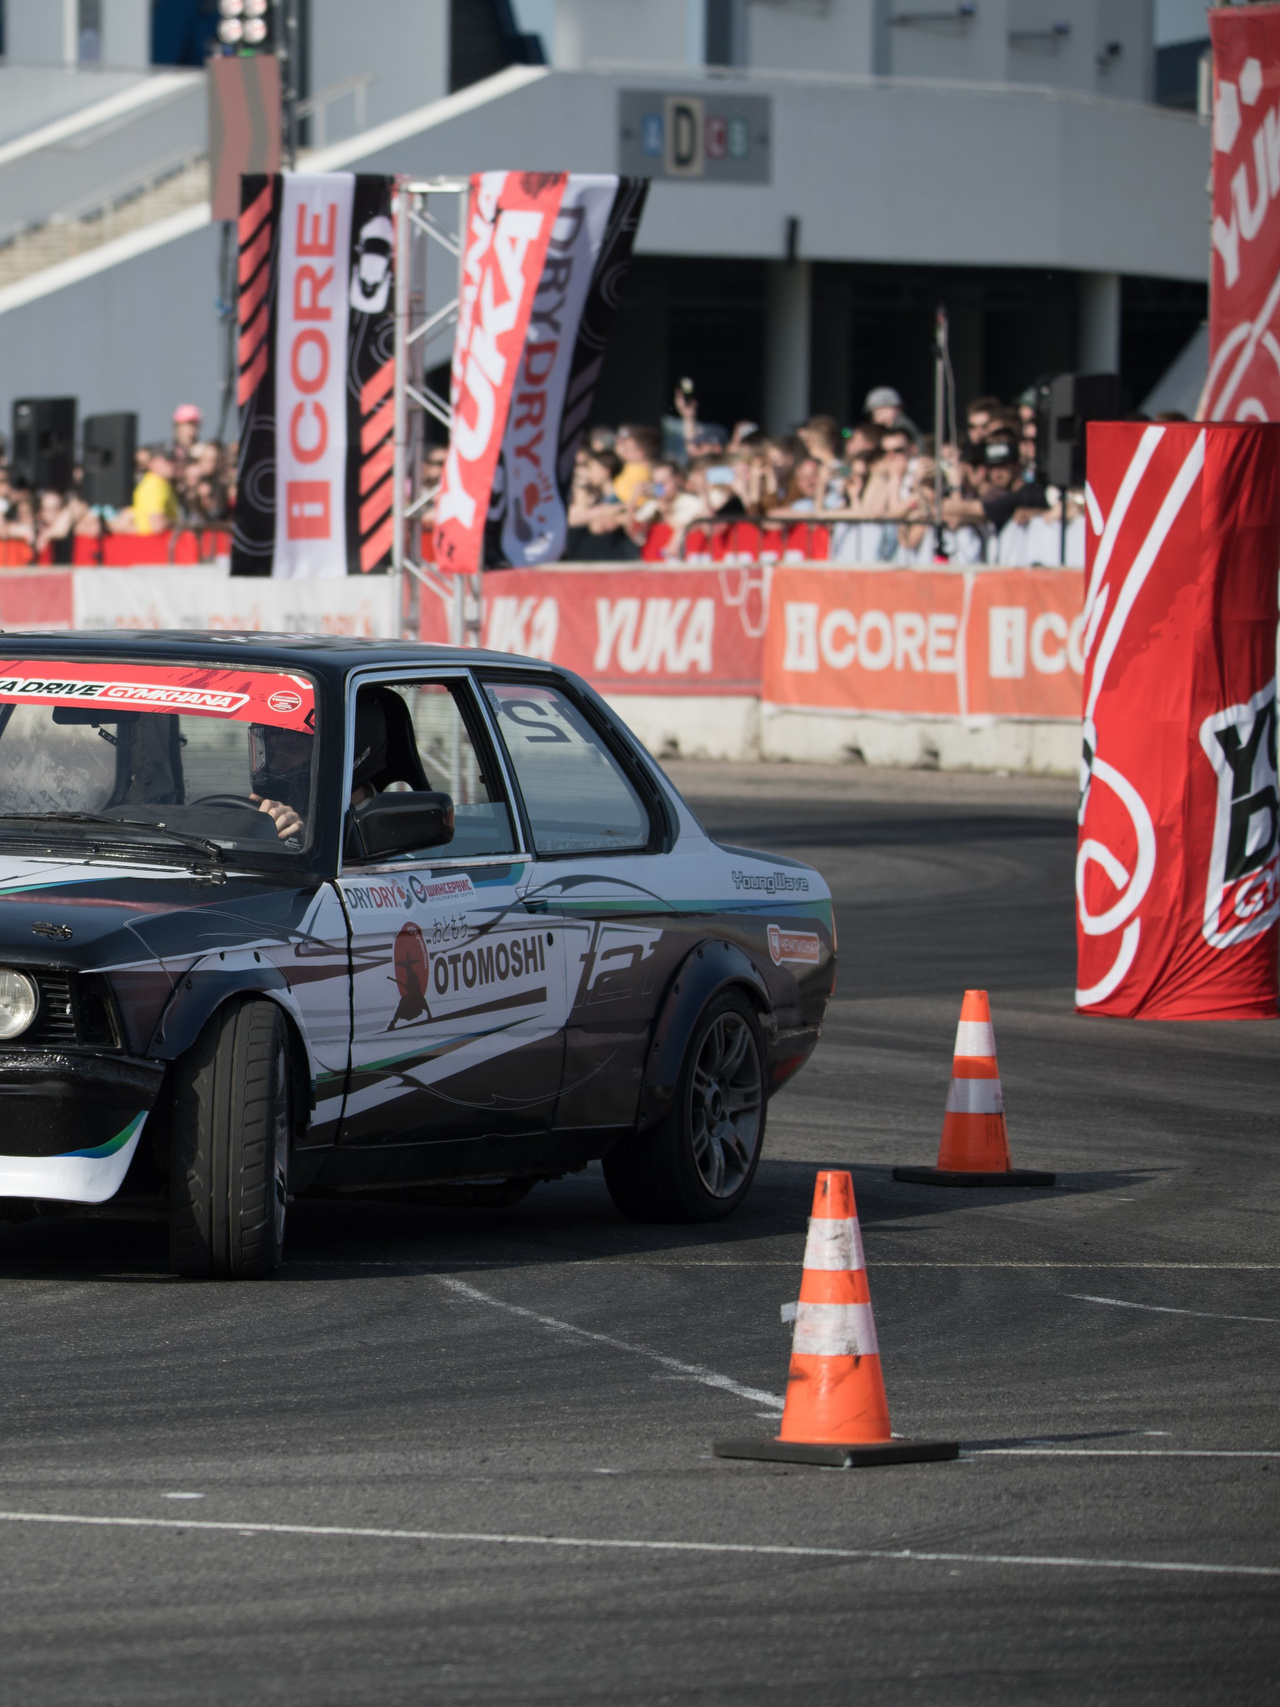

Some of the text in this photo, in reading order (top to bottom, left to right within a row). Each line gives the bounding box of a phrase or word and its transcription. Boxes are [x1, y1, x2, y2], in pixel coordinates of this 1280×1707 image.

[437, 210, 545, 529] YUKA
[595, 597, 716, 673] YUKA
[19, 681, 106, 697] DRIVE
[107, 687, 233, 708] GYMKHANA
[424, 878, 472, 898] ШИНСЕРВИС
[731, 870, 810, 895] YoungWave
[344, 885, 399, 909] DRYDRY
[433, 933, 546, 996] OTOMOSHI
